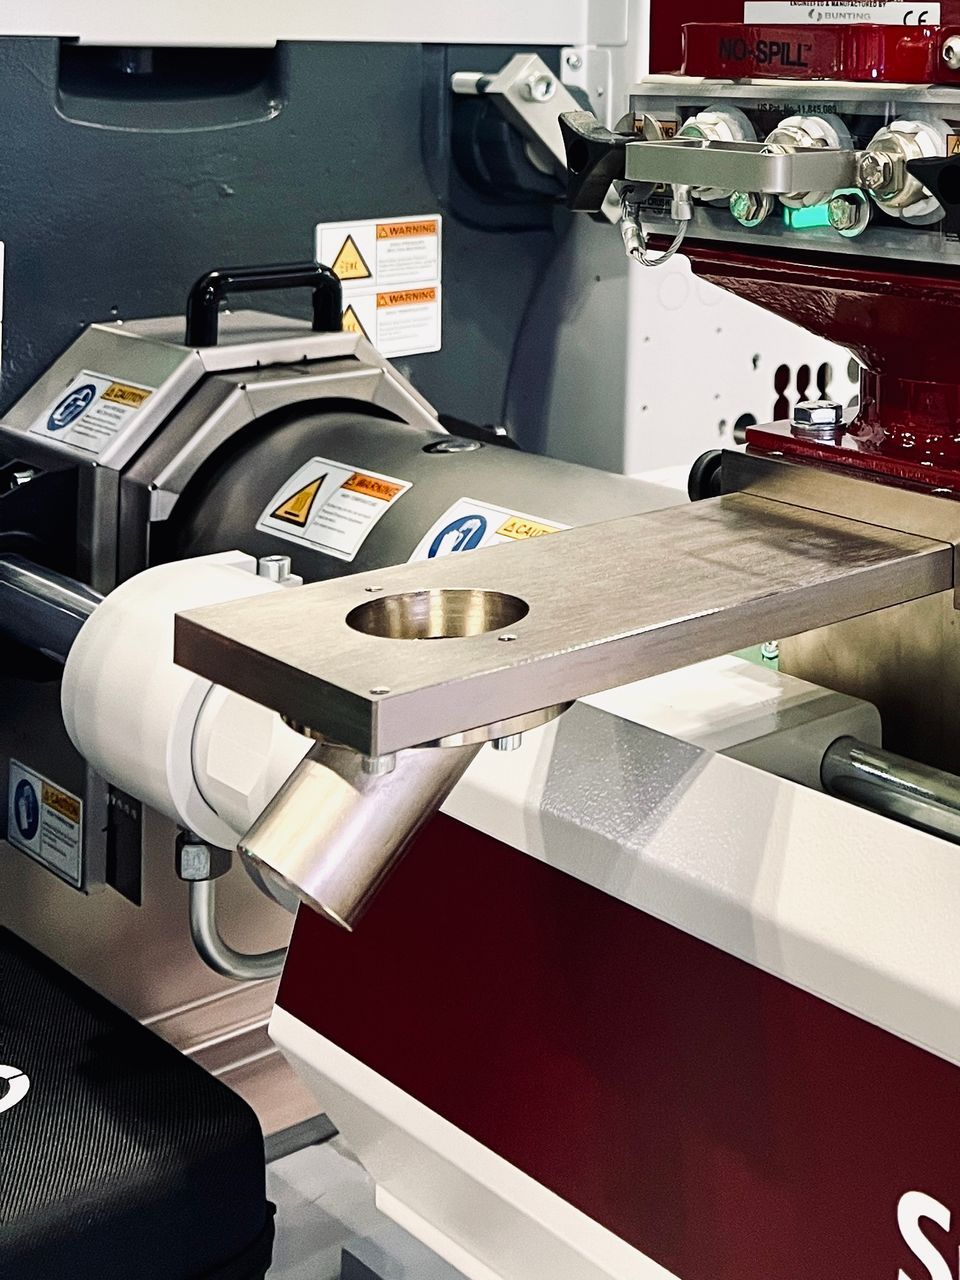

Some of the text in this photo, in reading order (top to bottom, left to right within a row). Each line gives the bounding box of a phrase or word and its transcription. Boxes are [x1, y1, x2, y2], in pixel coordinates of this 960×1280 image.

[824, 12, 871, 20] BUNTING
[389, 223, 436, 236] WARNING
[389, 290, 436, 304] WARNING
